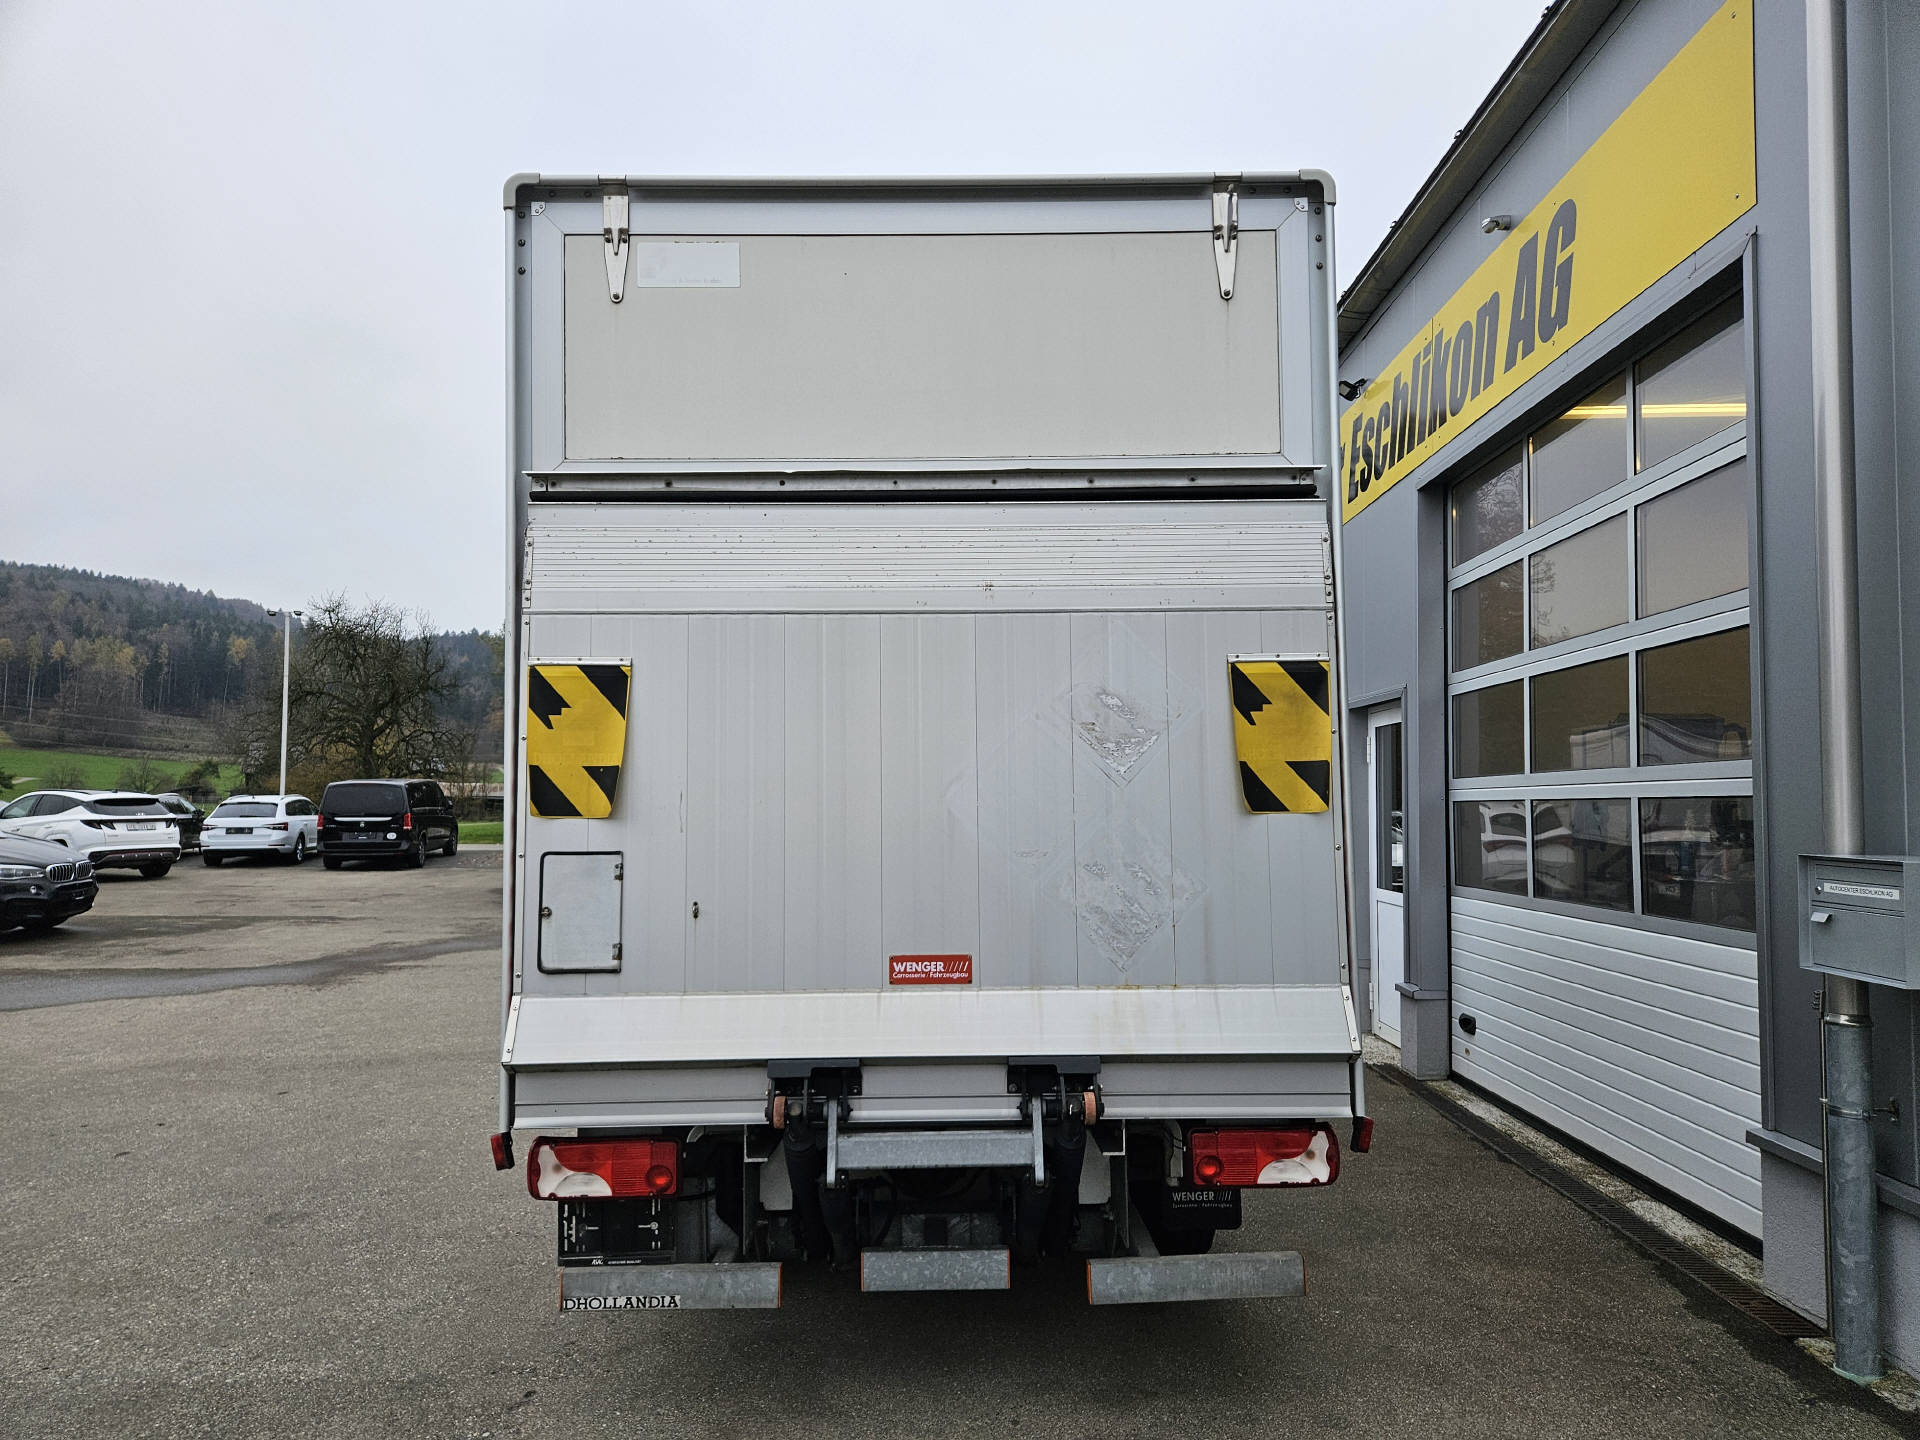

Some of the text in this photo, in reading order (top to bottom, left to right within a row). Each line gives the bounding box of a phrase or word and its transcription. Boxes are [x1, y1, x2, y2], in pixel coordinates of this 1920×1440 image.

[1347, 198, 1577, 504] Eschlikon AG
[893, 962, 944, 972] WENGER
[1172, 1191, 1215, 1202] WENGER
[563, 1295, 679, 1310] DHOLLANDIA
